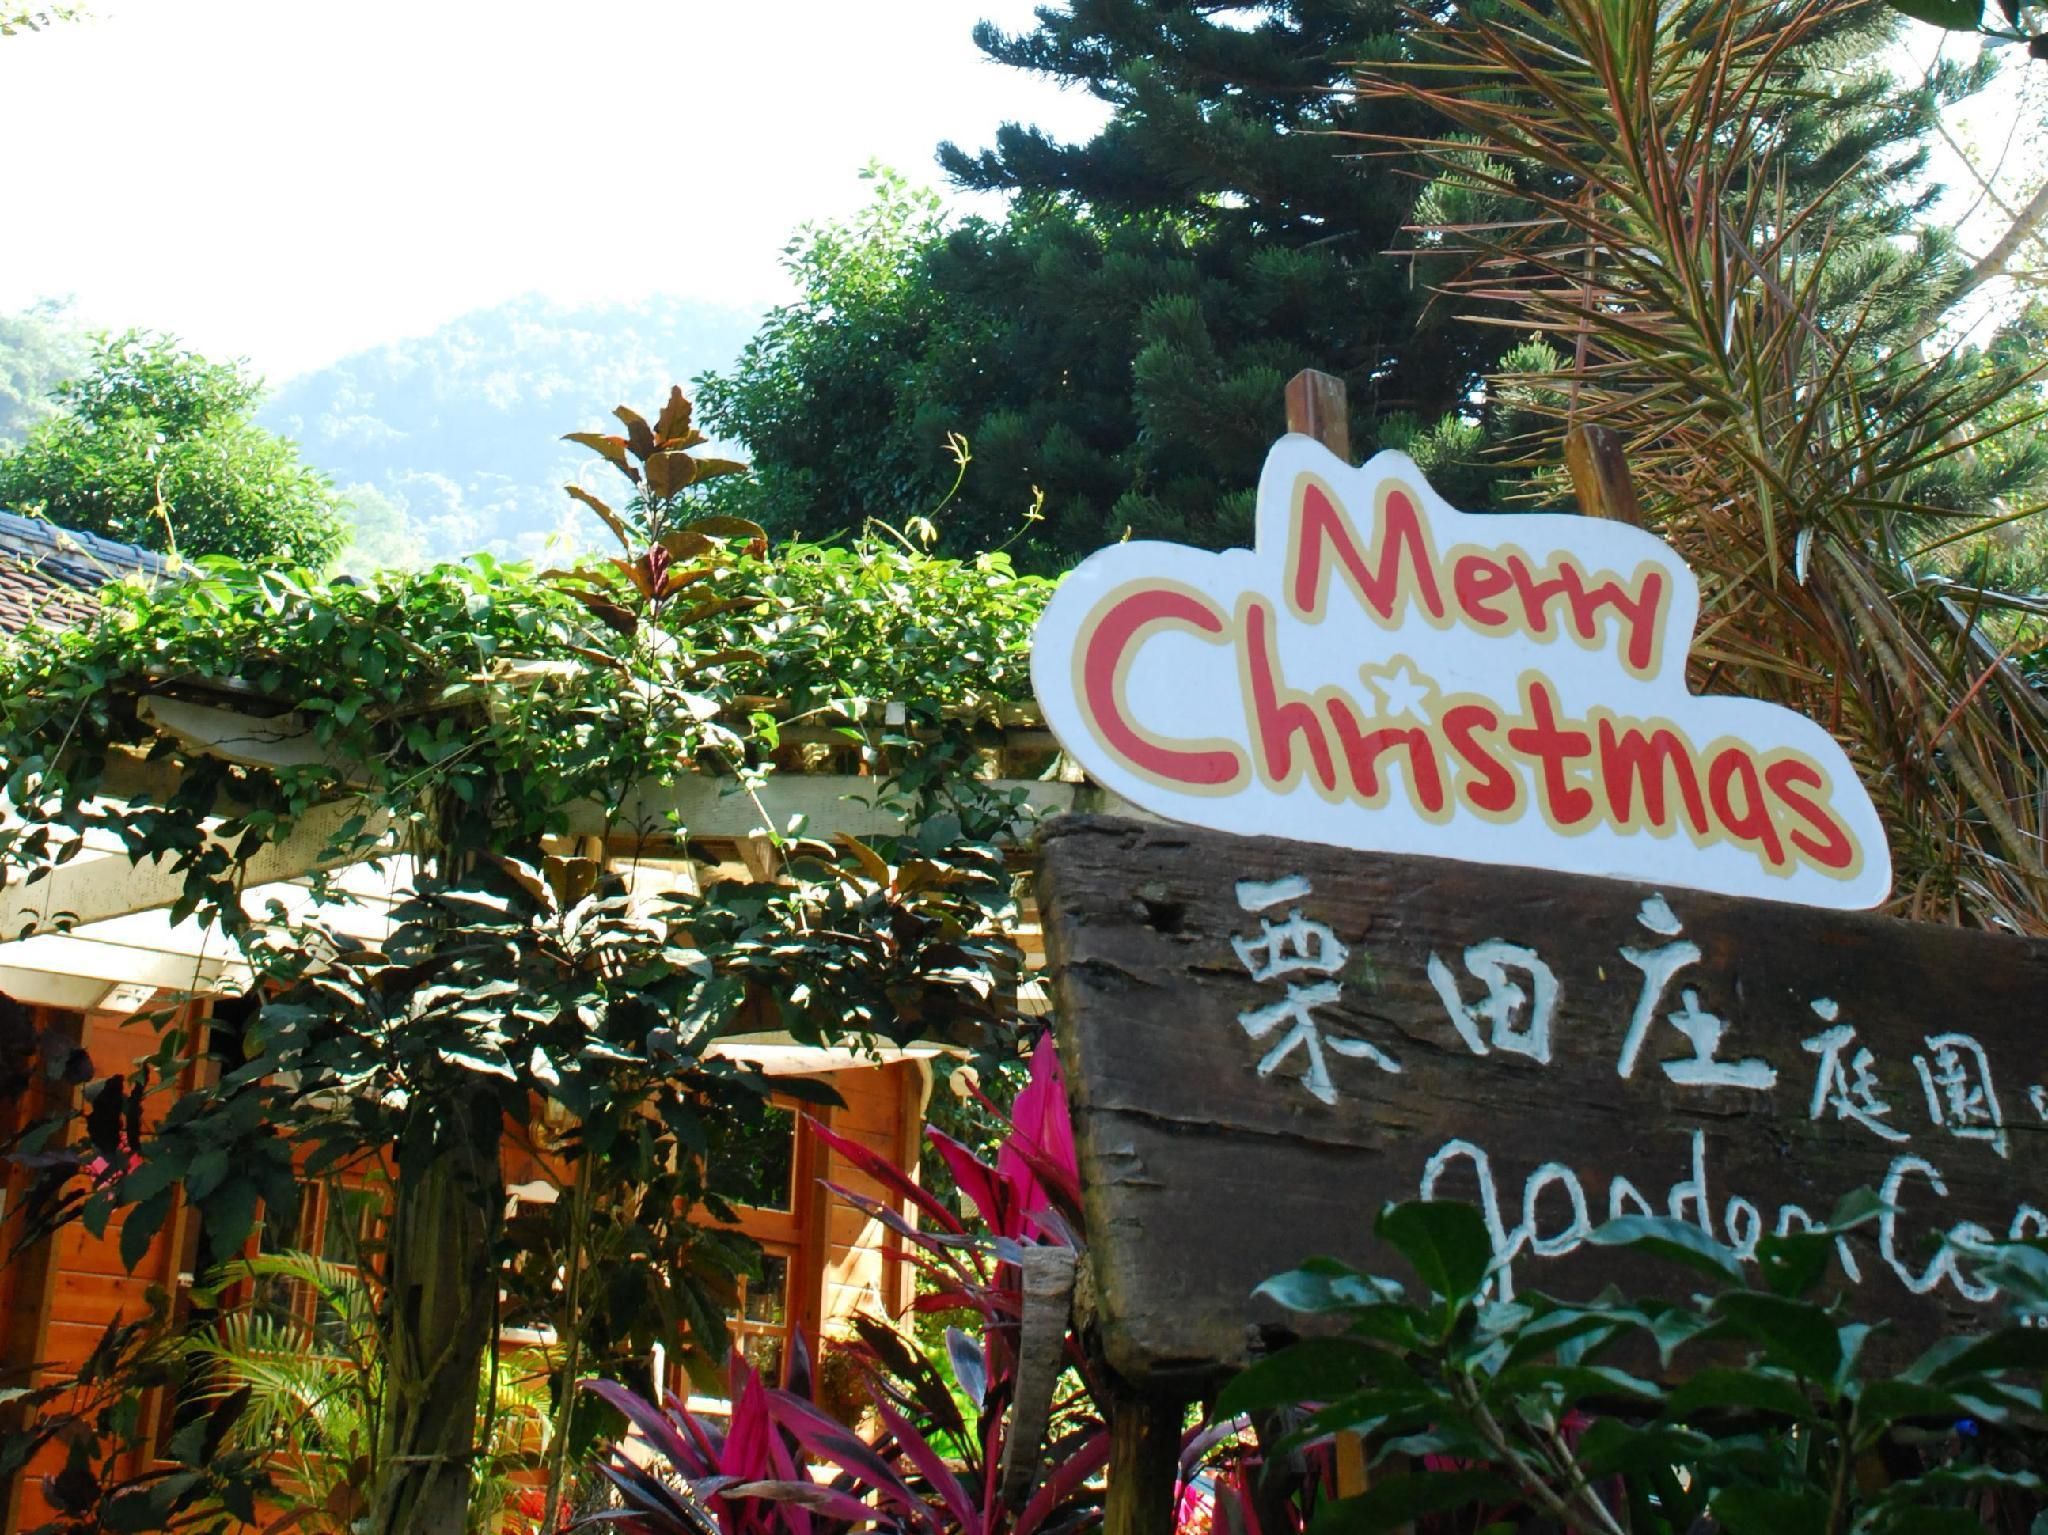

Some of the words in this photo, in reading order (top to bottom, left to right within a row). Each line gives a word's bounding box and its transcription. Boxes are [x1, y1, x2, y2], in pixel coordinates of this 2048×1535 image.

[1293, 482, 1663, 671] Merry
[1083, 588, 1854, 871] Christmas
[1230, 874, 2048, 1158] 栗田庄庭園
